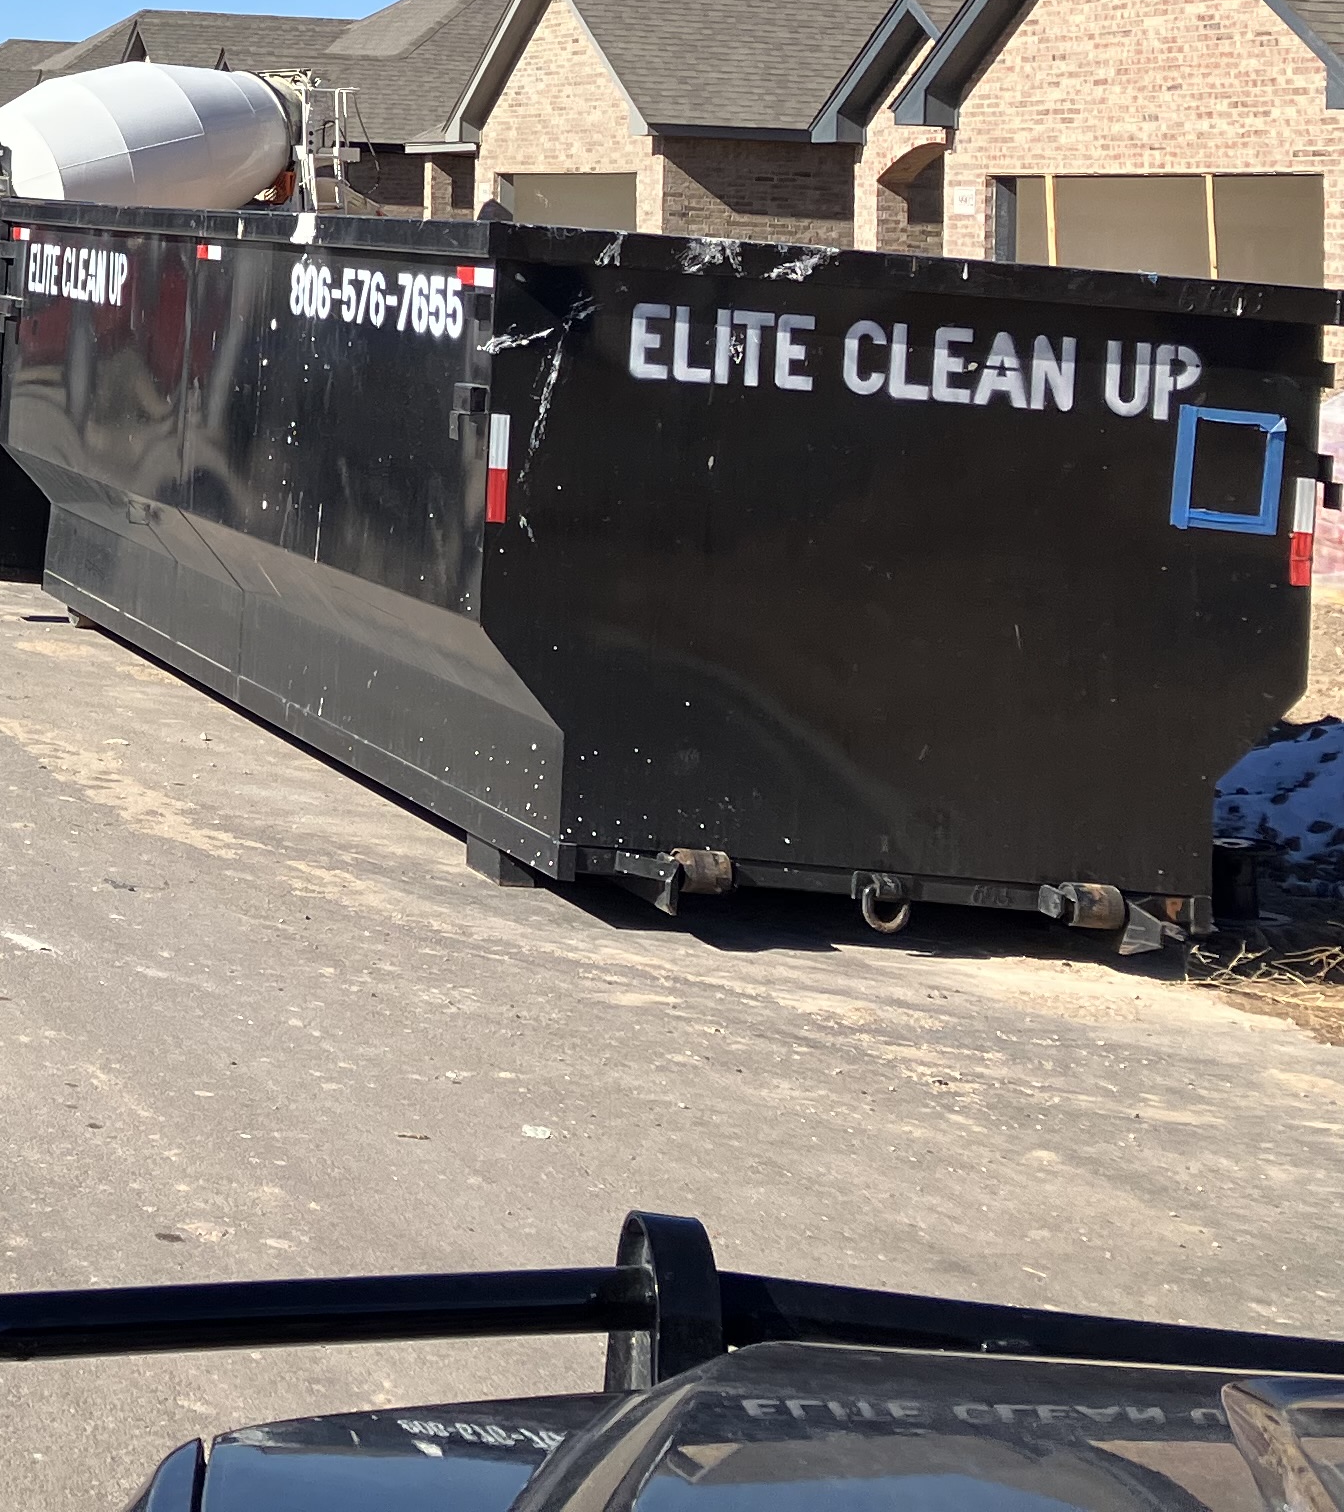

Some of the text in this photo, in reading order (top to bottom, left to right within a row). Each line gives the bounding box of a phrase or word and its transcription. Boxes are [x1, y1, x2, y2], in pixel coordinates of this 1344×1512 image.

[28, 243, 128, 306] ELITE CLEAN UP
[290, 262, 463, 338] 806-576-7655
[629, 303, 1202, 420] ELITE CLEAN UP
